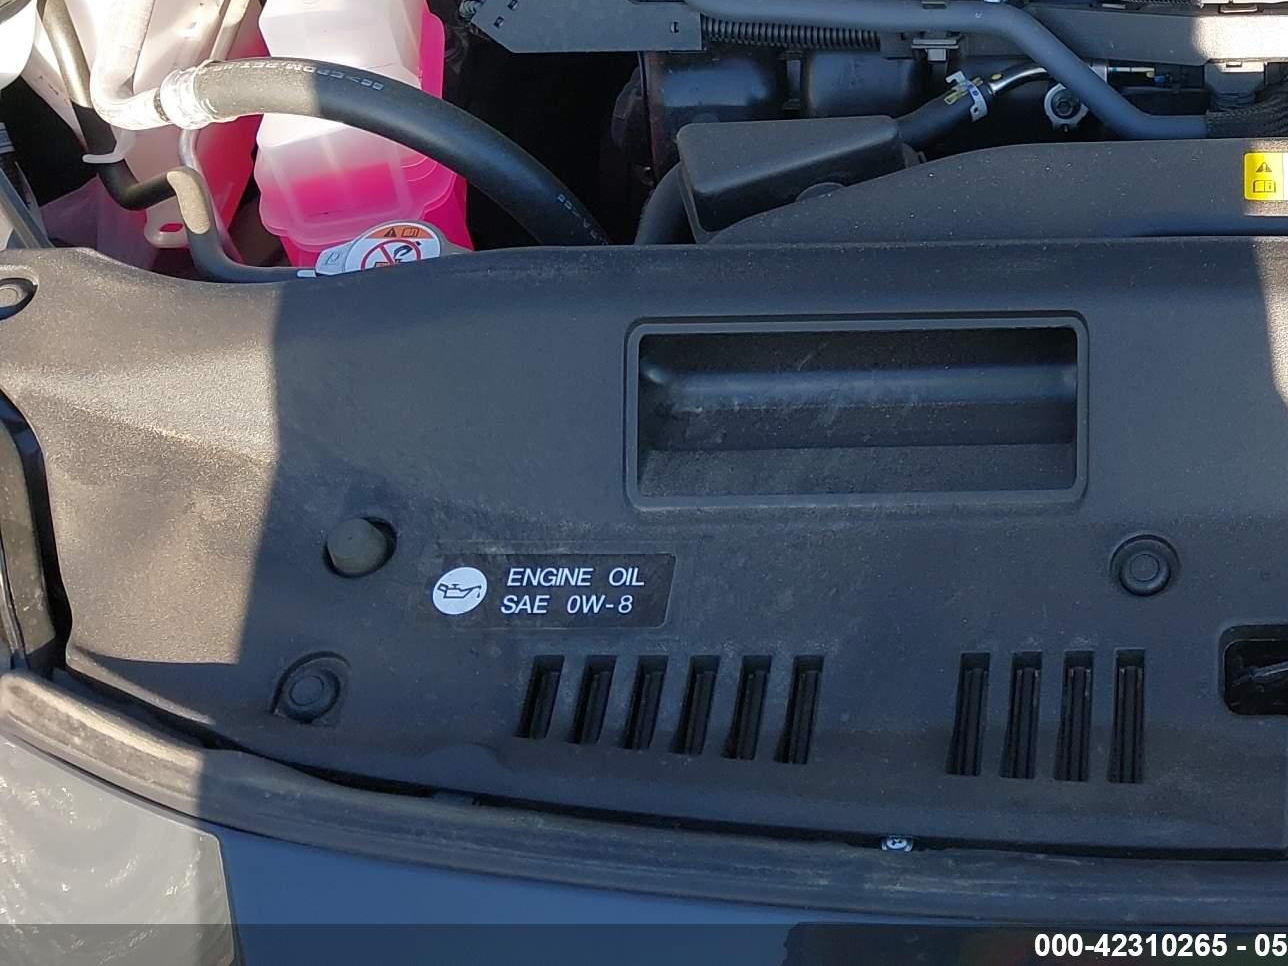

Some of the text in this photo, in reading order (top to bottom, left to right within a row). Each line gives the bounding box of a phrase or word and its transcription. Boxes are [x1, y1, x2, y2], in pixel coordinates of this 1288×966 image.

[506, 567, 645, 587] ENGINE OIL
[500, 594, 633, 614] SAE 0W-8
